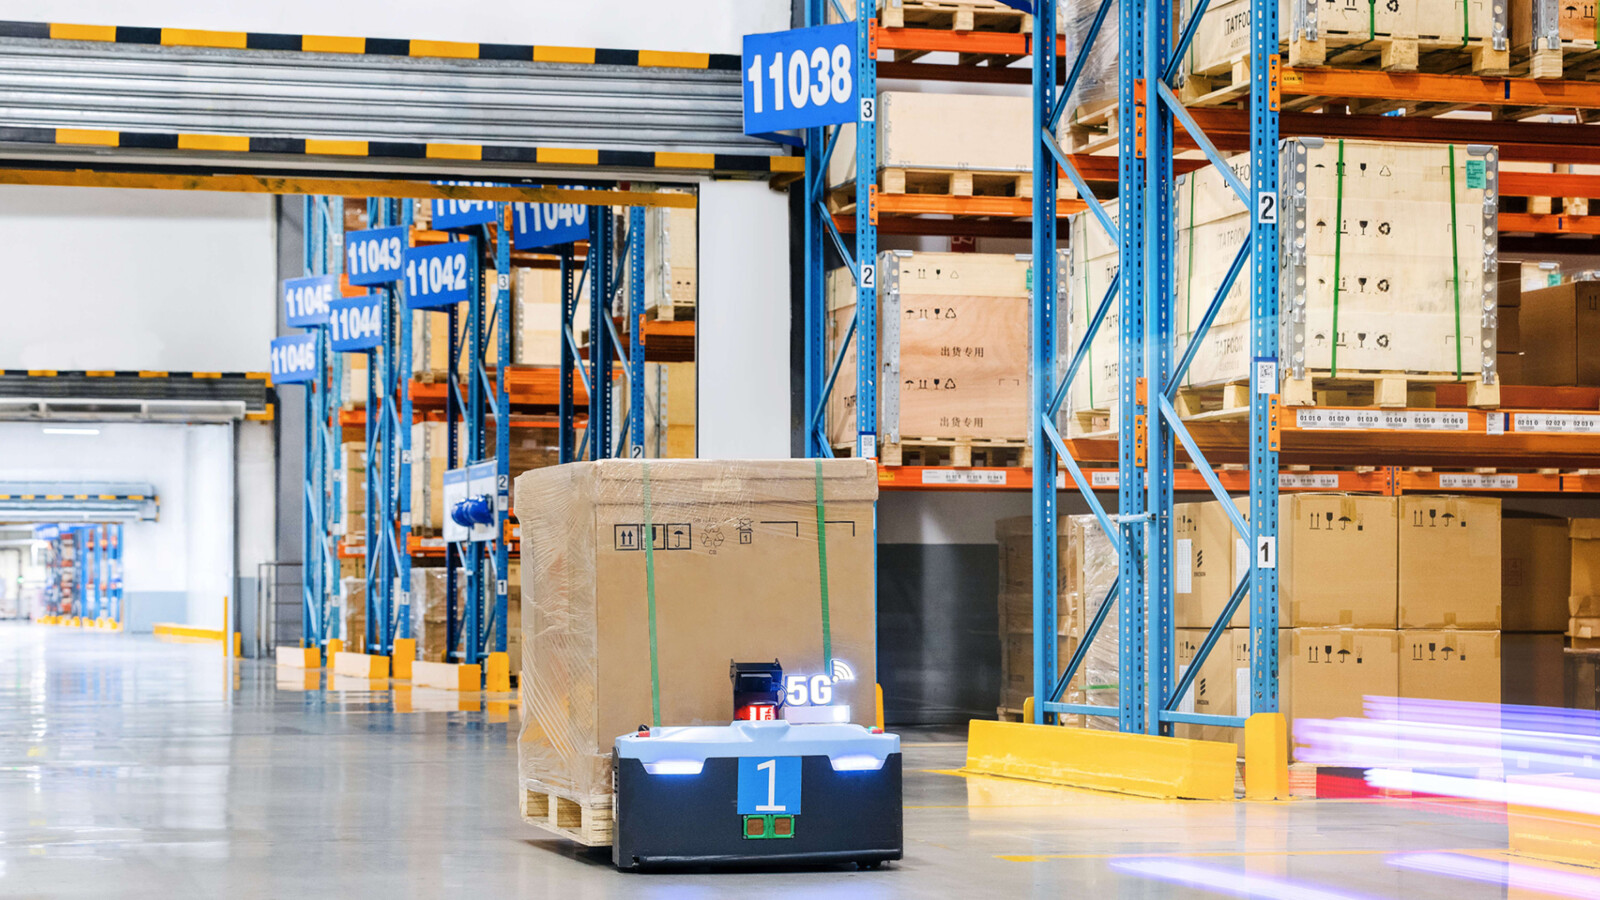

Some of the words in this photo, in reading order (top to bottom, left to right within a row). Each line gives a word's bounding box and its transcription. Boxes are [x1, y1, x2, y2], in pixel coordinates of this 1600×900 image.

[1225, 10, 1251, 36] TATFOO
[747, 43, 852, 114] 11038
[863, 101, 873, 119] 3
[1260, 195, 1274, 220] 2
[348, 236, 402, 275] 11043
[406, 253, 467, 297] 11042
[499, 275, 507, 289] 3
[863, 267, 873, 285] 2
[286, 283, 333, 319] 11045
[329, 304, 382, 342] 11044
[271, 341, 316, 375] 11046
[940, 346, 985, 358] 出货专用
[939, 417, 984, 428] 出货专用
[633, 446, 641, 459] 2
[499, 475, 507, 488] 2
[1261, 541, 1269, 562] 1
[785, 673, 832, 706] 5G
[755, 759, 786, 811] 1
